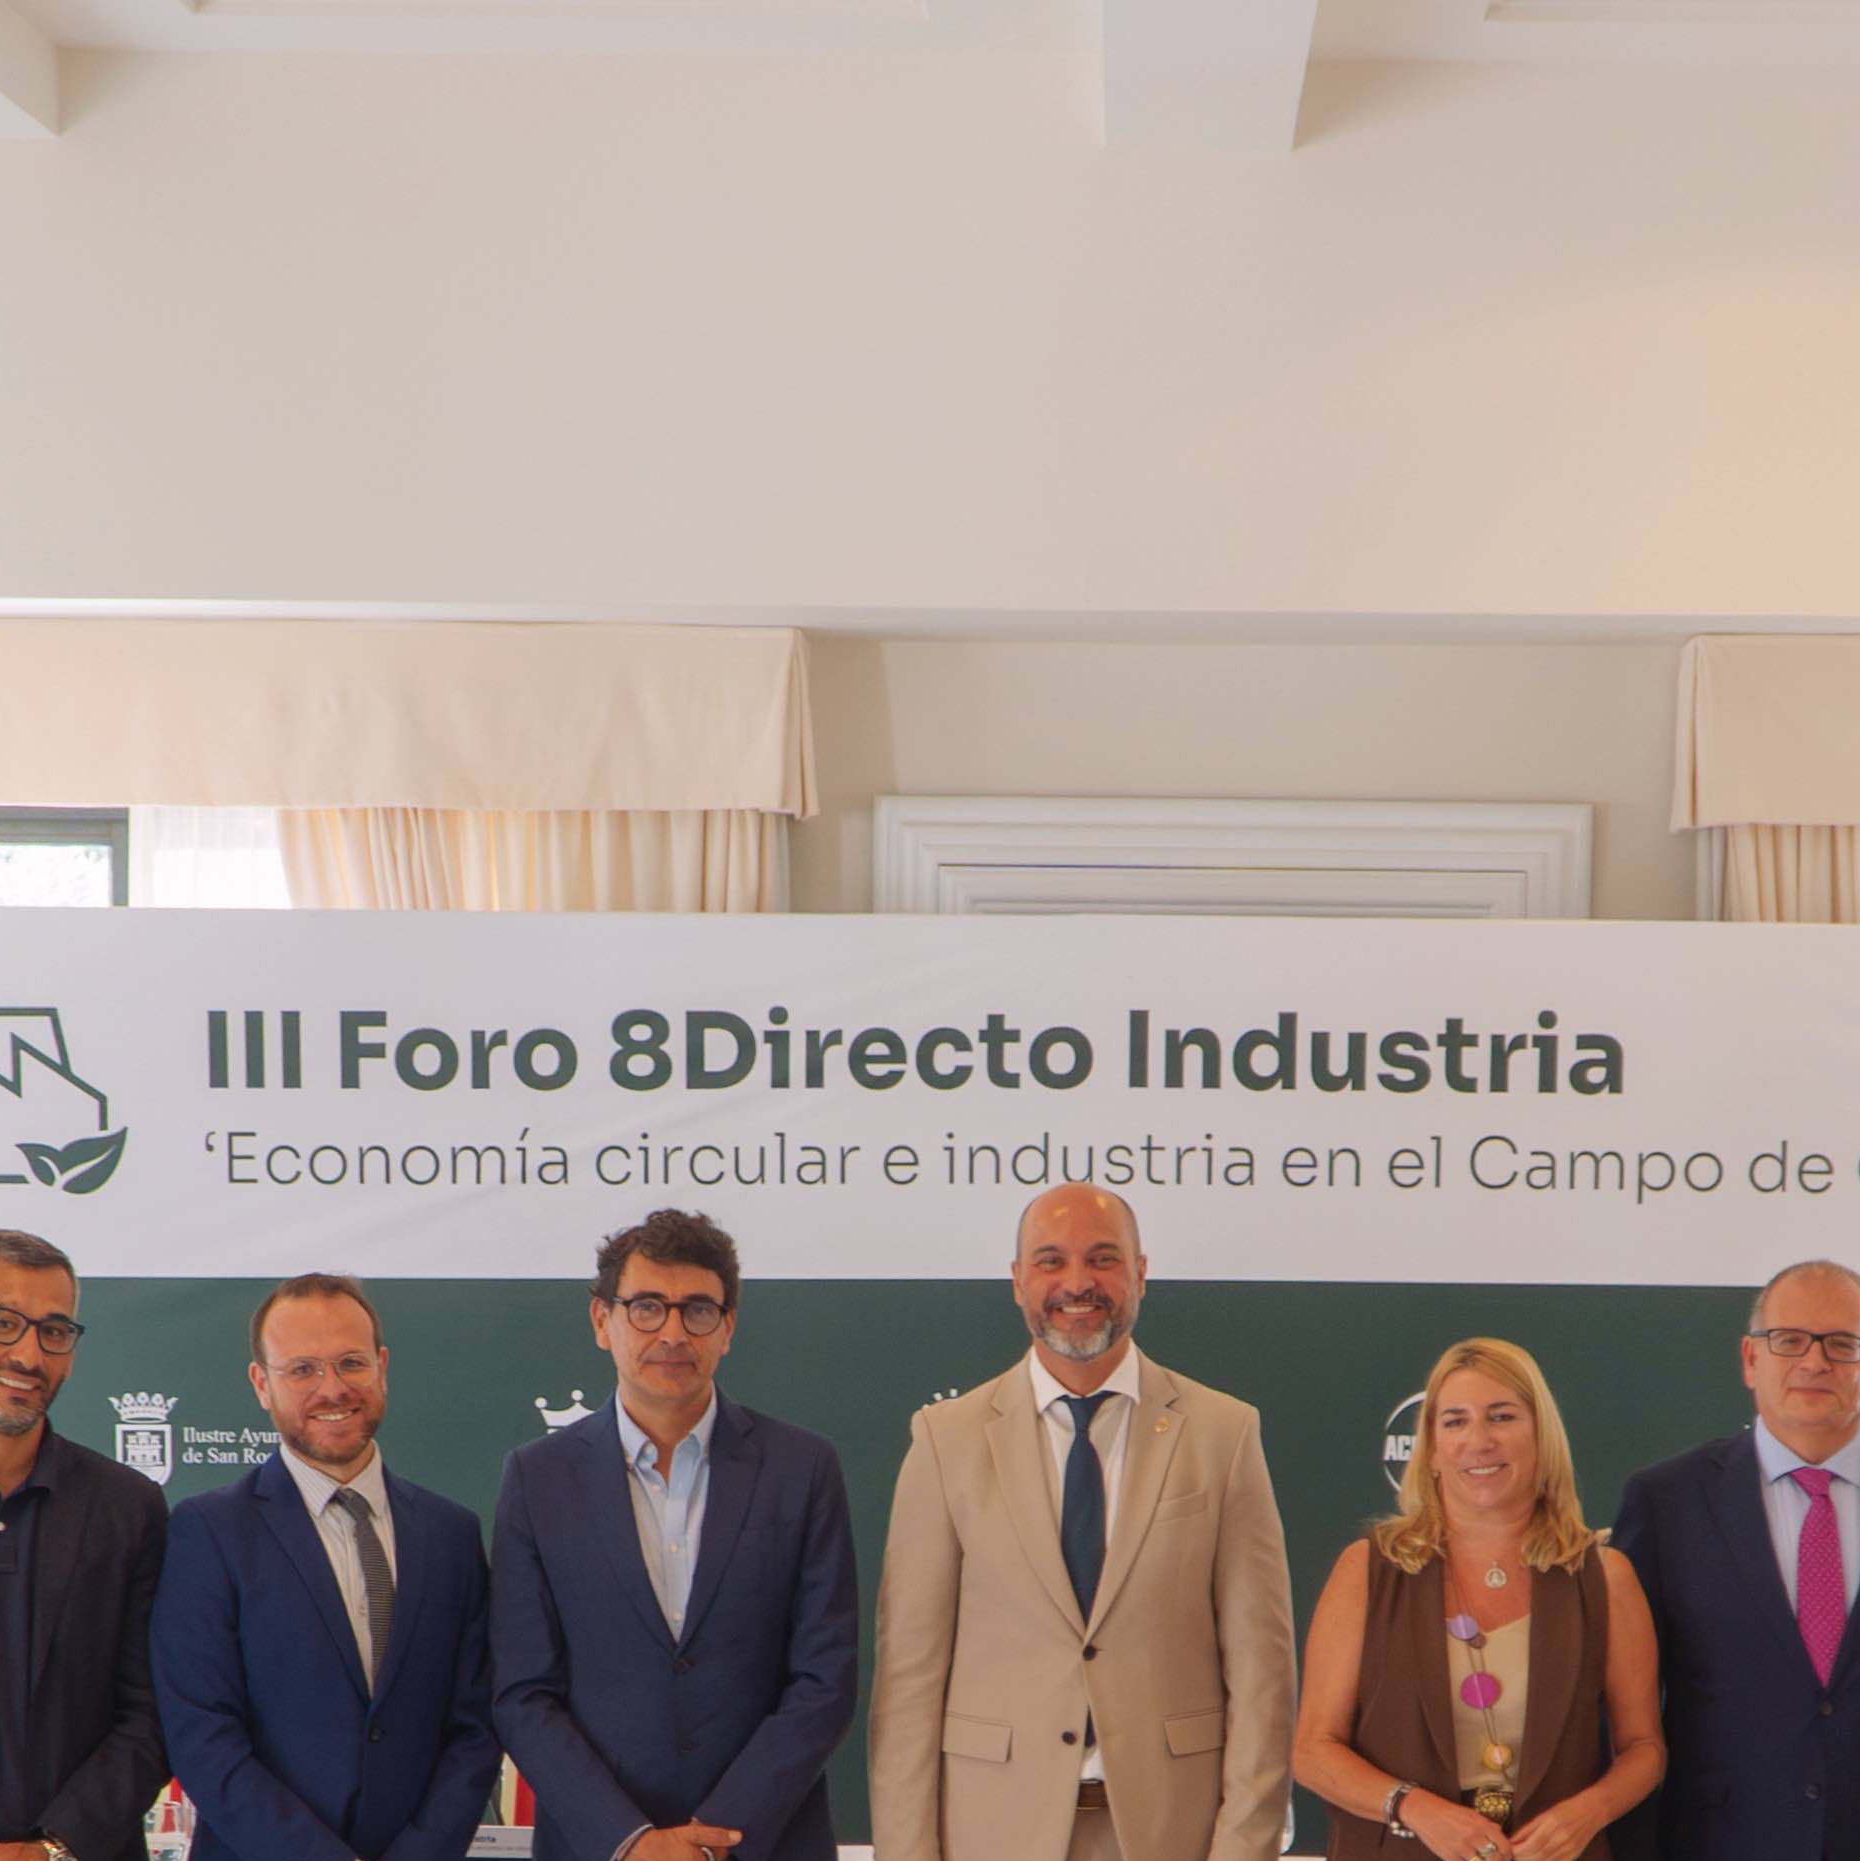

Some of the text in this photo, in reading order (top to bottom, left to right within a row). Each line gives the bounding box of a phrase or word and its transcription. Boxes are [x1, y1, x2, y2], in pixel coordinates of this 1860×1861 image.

[209, 1007, 1625, 1096] III Foro 8Directo Industria
[596, 1133, 861, 1187] circular
[883, 1146, 921, 1187] e
[944, 1132, 1256, 1189] industria
[1282, 1148, 1362, 1189] en
[1388, 1136, 1443, 1190] el
[1469, 1136, 1725, 1206] Campo
[1749, 1141, 1835, 1195] de
[182, 1447, 204, 1464] de
[206, 1447, 239, 1464] San
[183, 1426, 281, 1448] Ilustre Ayun
